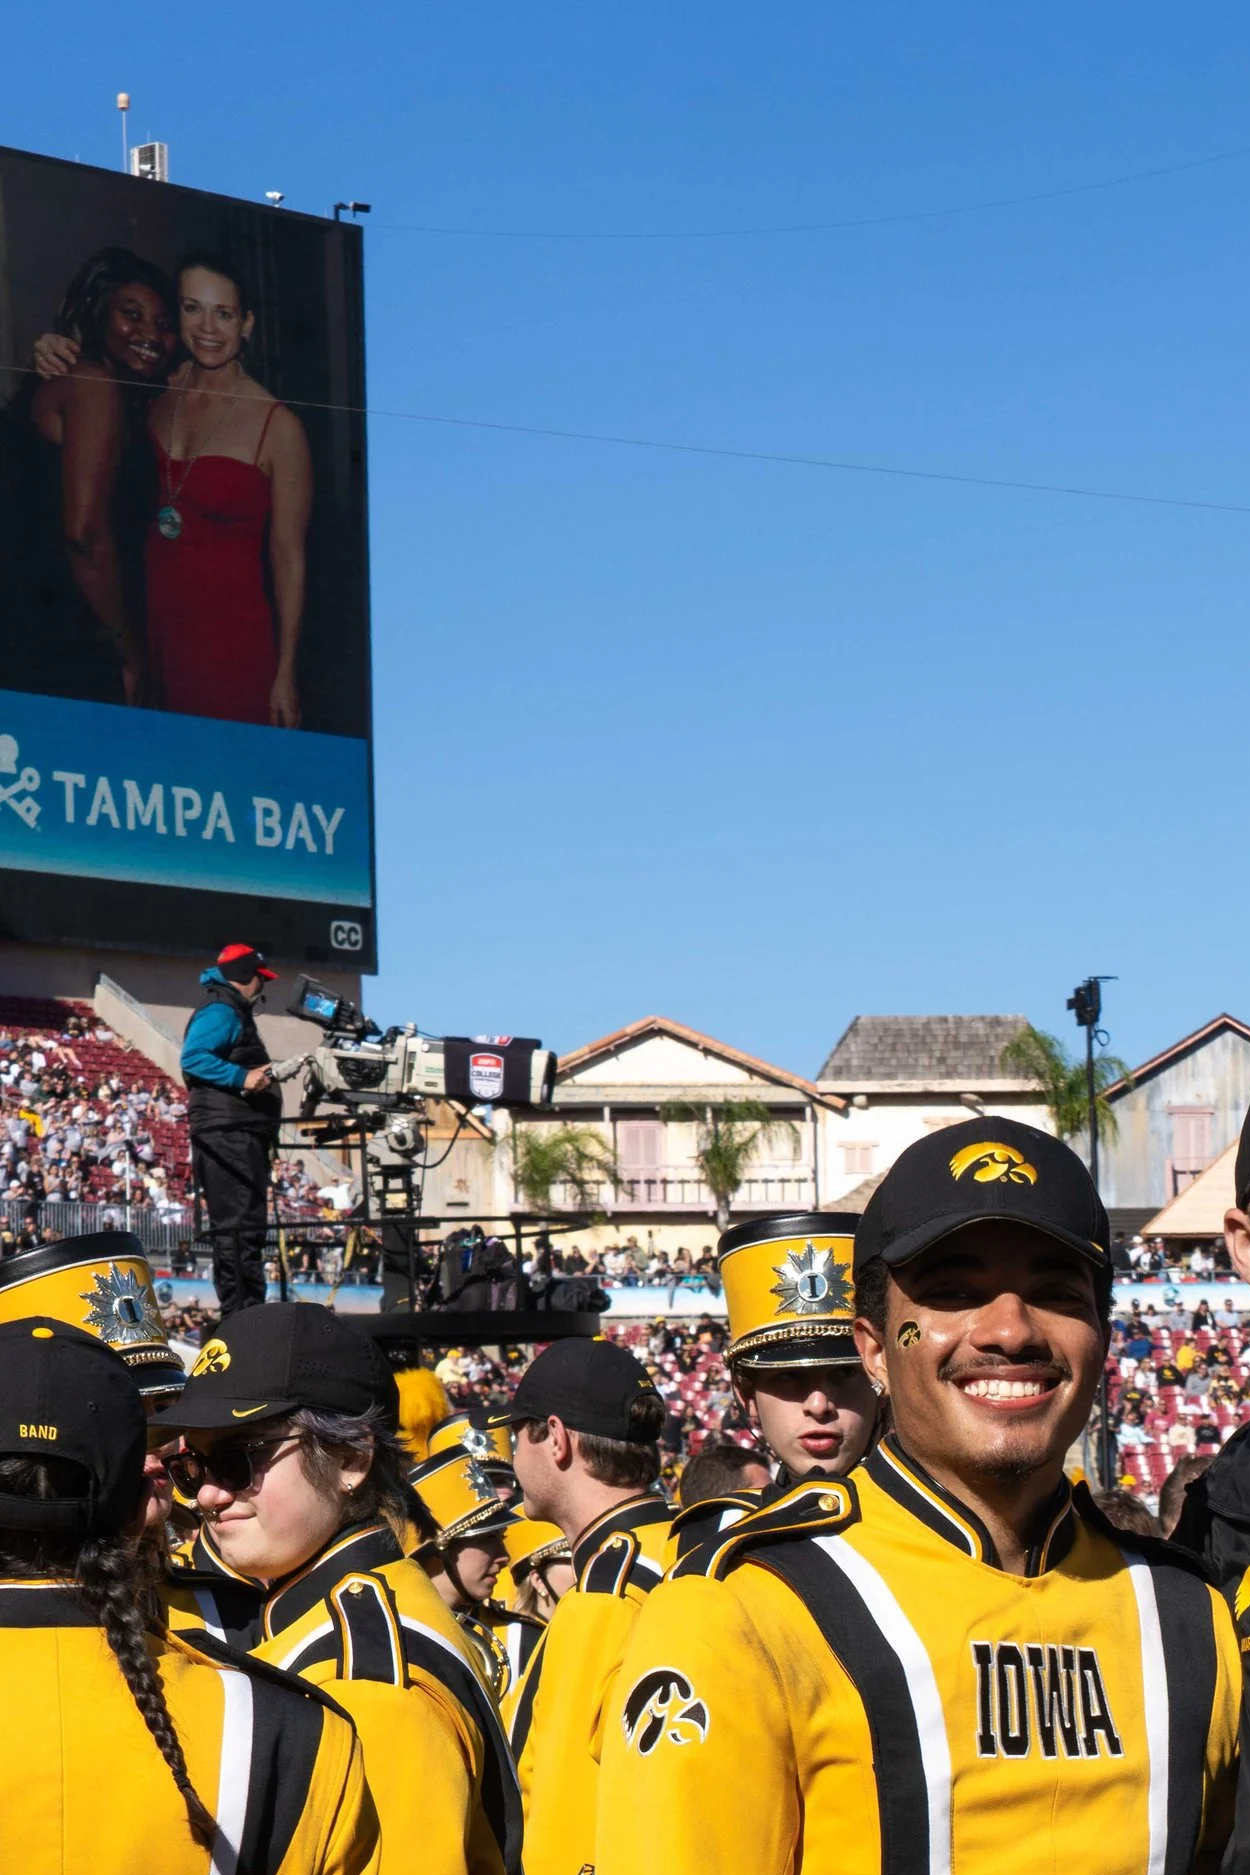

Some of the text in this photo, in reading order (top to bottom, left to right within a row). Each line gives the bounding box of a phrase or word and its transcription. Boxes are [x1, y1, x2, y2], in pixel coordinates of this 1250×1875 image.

[52, 770, 346, 856] TAMPA BAY
[332, 925, 361, 946] CC
[19, 1423, 58, 1441] BAND
[969, 1640, 1125, 1760] IOWA
